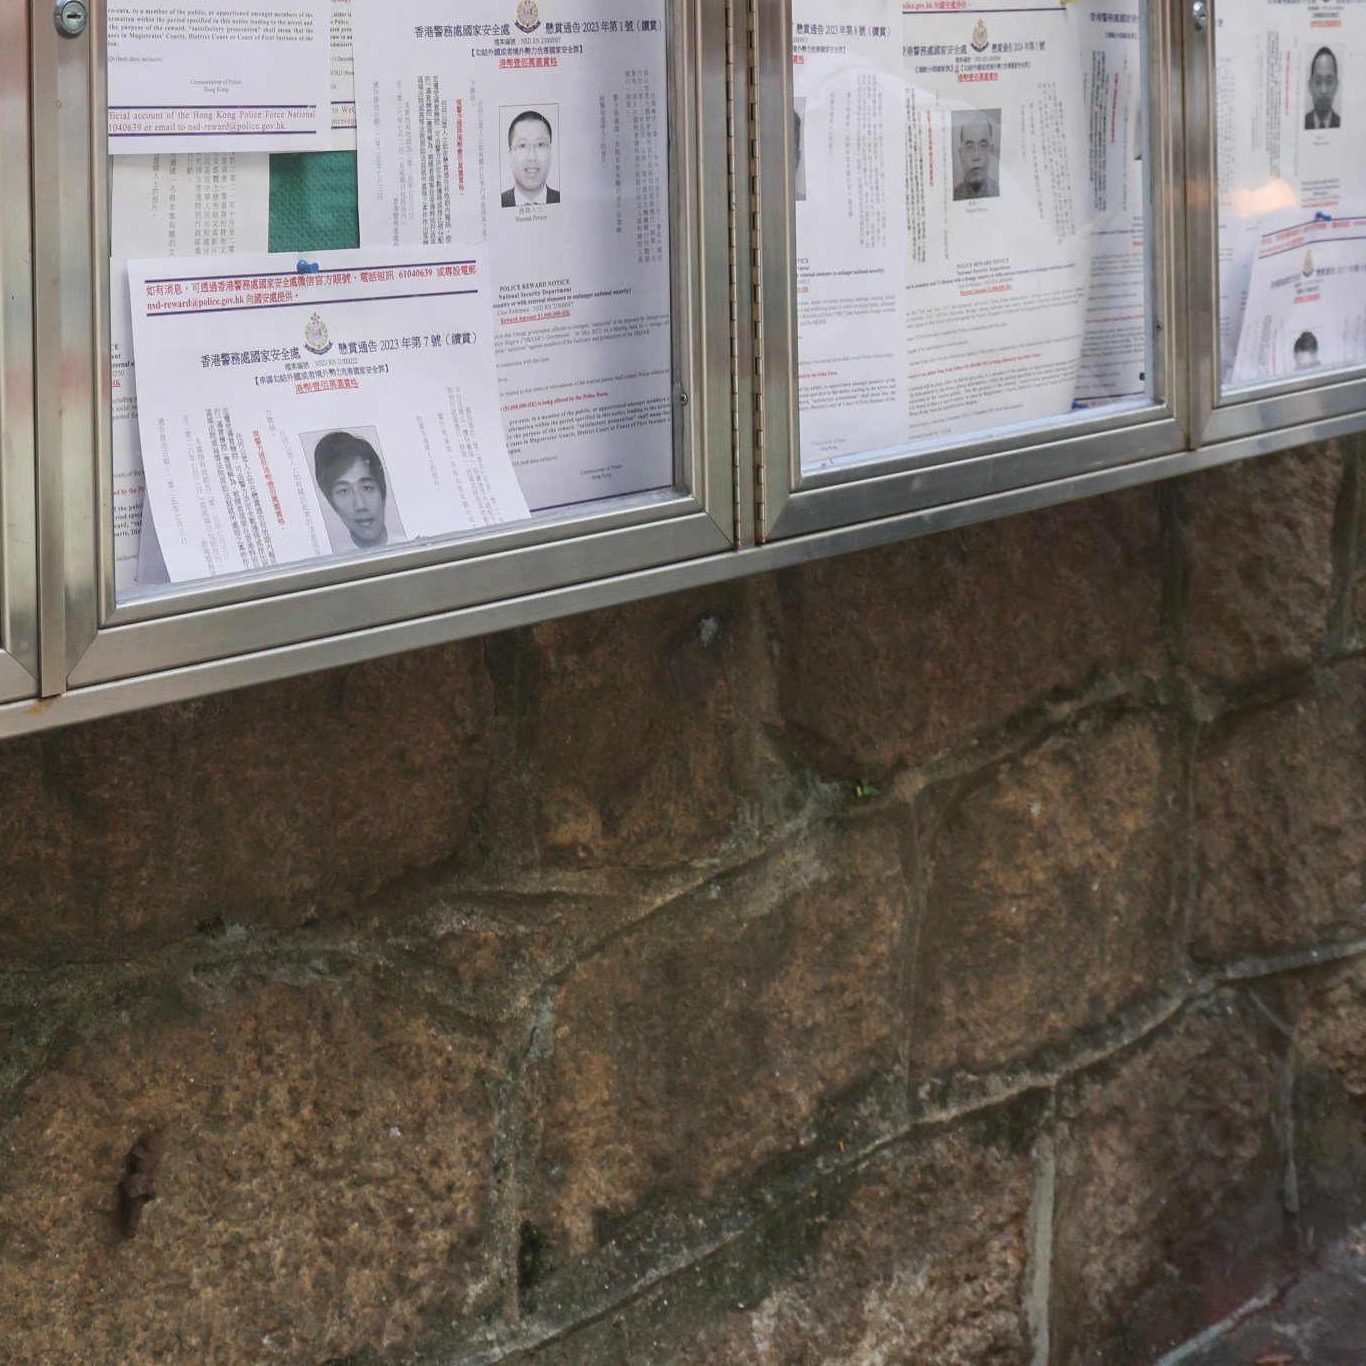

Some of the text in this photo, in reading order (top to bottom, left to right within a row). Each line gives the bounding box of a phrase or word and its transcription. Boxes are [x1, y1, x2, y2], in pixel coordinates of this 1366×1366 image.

[415, 24, 510, 37] 香港警務處國家安全處
[546, 22, 580, 34] 懸賞通告
[583, 22, 599, 33] 2023
[602, 21, 618, 33] 年第
[621, 22, 623, 31] 1
[826, 25, 838, 36] 2023
[134, 111, 161, 119] account
[167, 111, 175, 119] of
[178, 111, 190, 119] the
[193, 111, 213, 121] Hong
[216, 111, 236, 121] Kong
[240, 110, 261, 118] Police
[265, 110, 284, 118] Force
[288, 110, 315, 118] National
[109, 123, 141, 131] 1040639
[155, 122, 175, 131] email
[178, 122, 185, 130] to
[399, 268, 432, 279] 61040639
[437, 265, 476, 278] 或專設電郵
[147, 295, 244, 310] nsd-reward@police.gov.hk
[201, 347, 300, 368] 香港警務處國家安全處
[338, 339, 377, 355] 懸賞通告
[380, 338, 399, 351] 2023
[401, 336, 421, 350] 年第
[424, 336, 428, 346] 7
